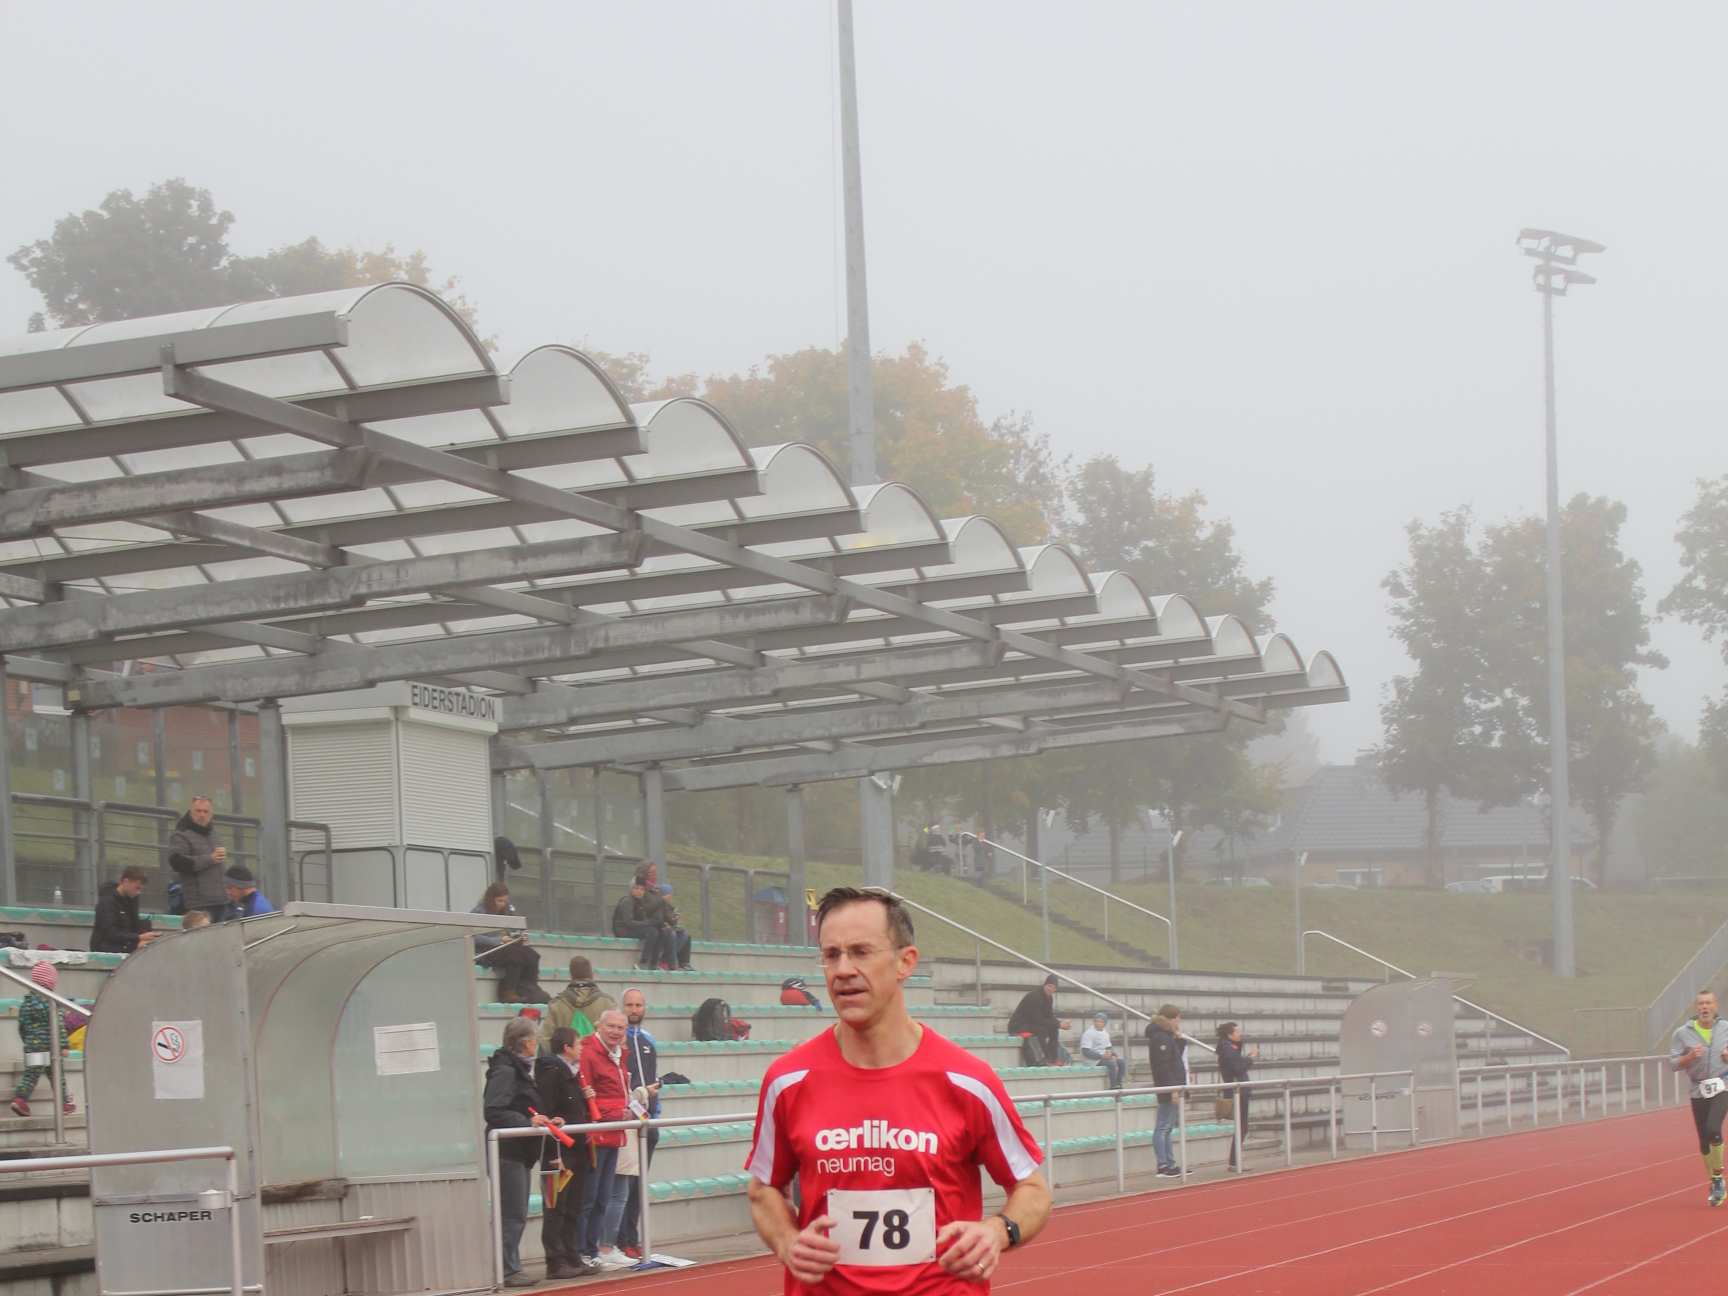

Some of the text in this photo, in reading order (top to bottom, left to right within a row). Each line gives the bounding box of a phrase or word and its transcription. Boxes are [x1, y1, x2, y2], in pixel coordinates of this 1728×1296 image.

[411, 684, 495, 720] EIDERSTADION
[1704, 1082, 1717, 1095] 97
[817, 1156, 895, 1177] neumag
[129, 1210, 213, 1223] SCHAPER
[852, 1209, 911, 1250] 78
